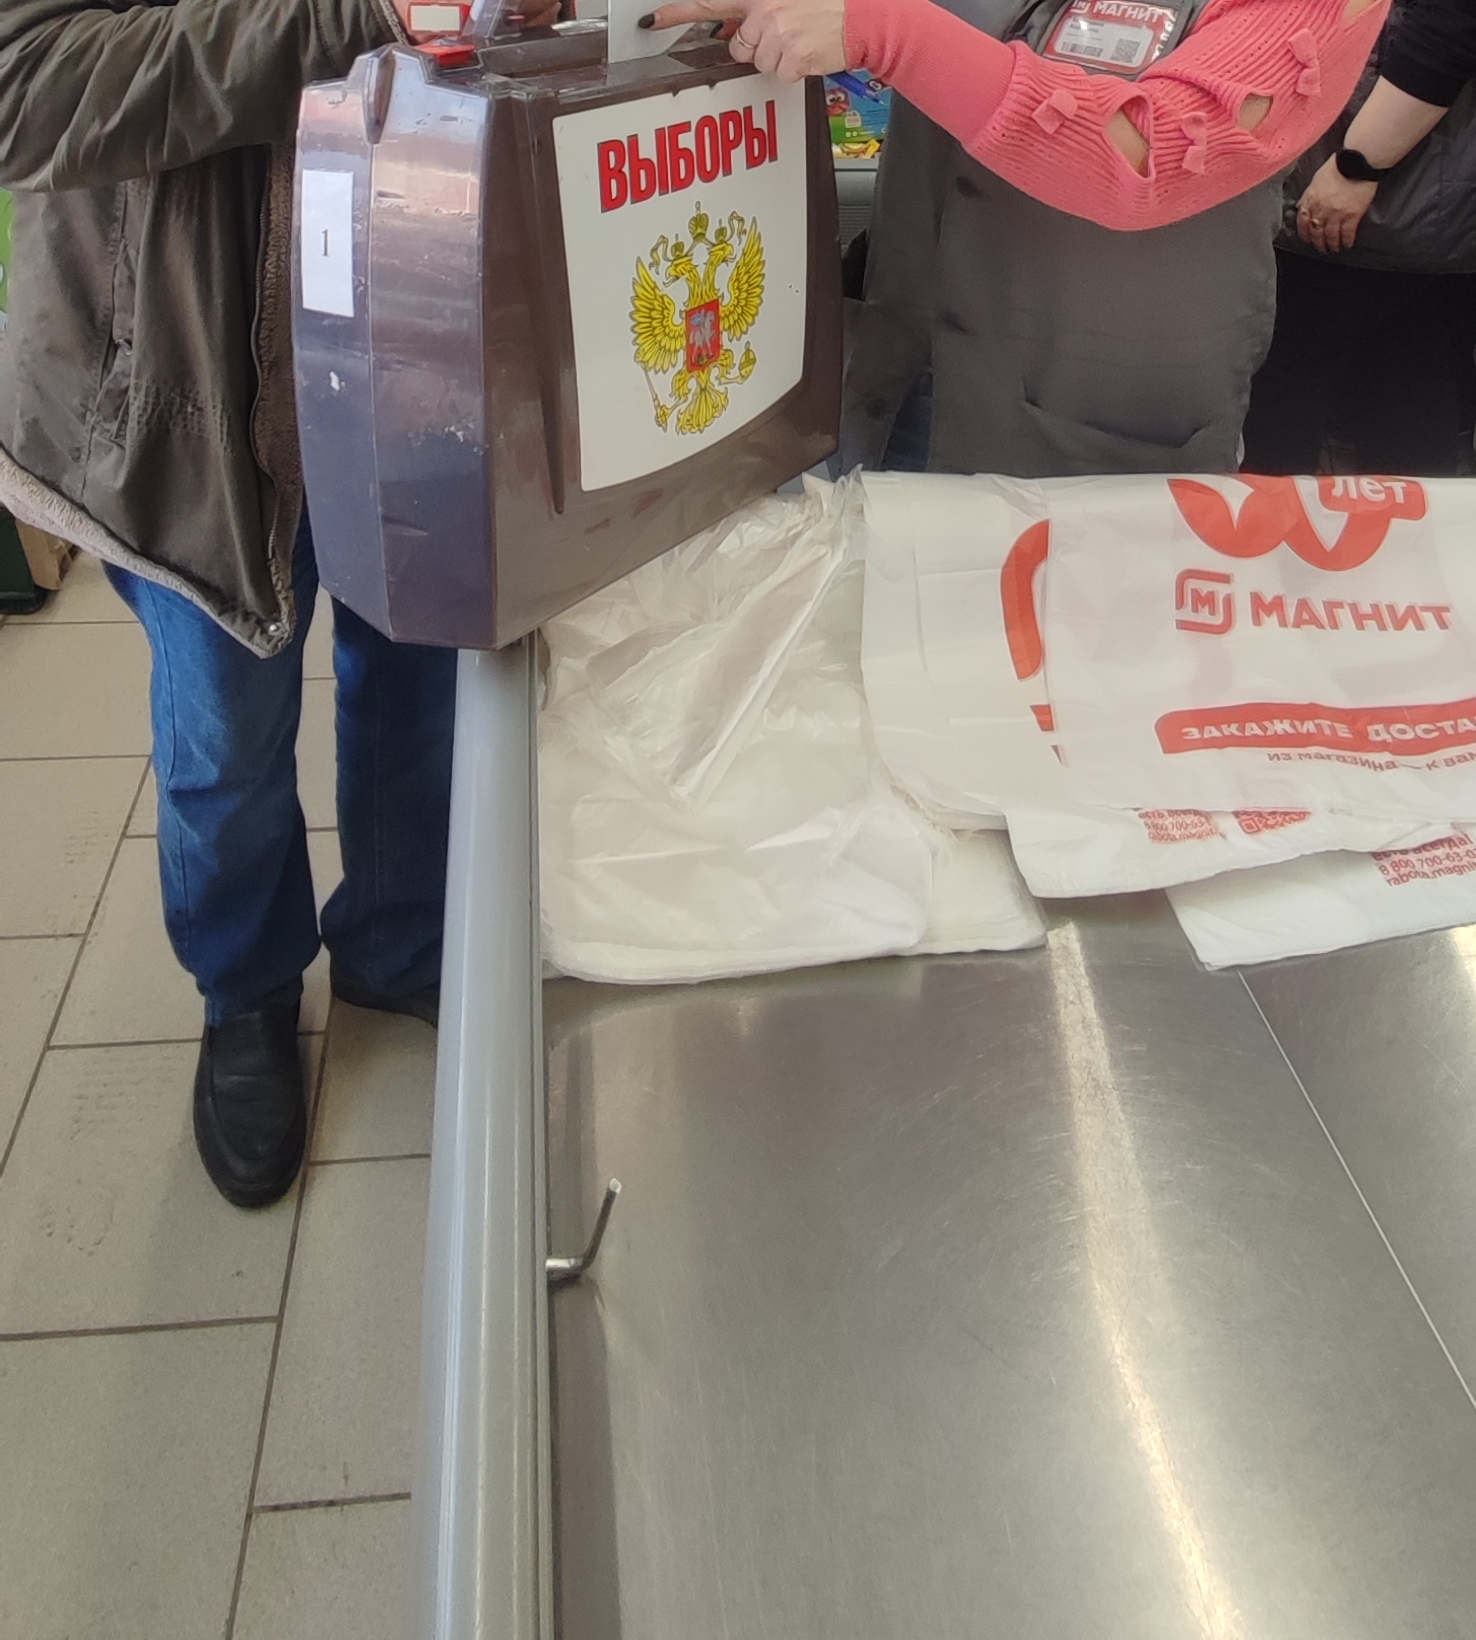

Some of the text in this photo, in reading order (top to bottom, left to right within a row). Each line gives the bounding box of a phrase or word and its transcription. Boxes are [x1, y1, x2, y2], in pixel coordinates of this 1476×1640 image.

[1093, 1, 1161, 23] МАГНИТ
[597, 100, 778, 214] ВЫБОРЫ
[321, 228, 330, 258] 1
[1331, 476, 1407, 504] лет
[1250, 591, 1452, 631] МАГНИТ
[1181, 716, 1476, 743] ЗАКАЖИТЕ ДОСТА
[1267, 752, 1293, 761] из
[1298, 752, 1399, 772] магазина
[1379, 864, 1390, 877] 8
[1390, 859, 1416, 874] 800
